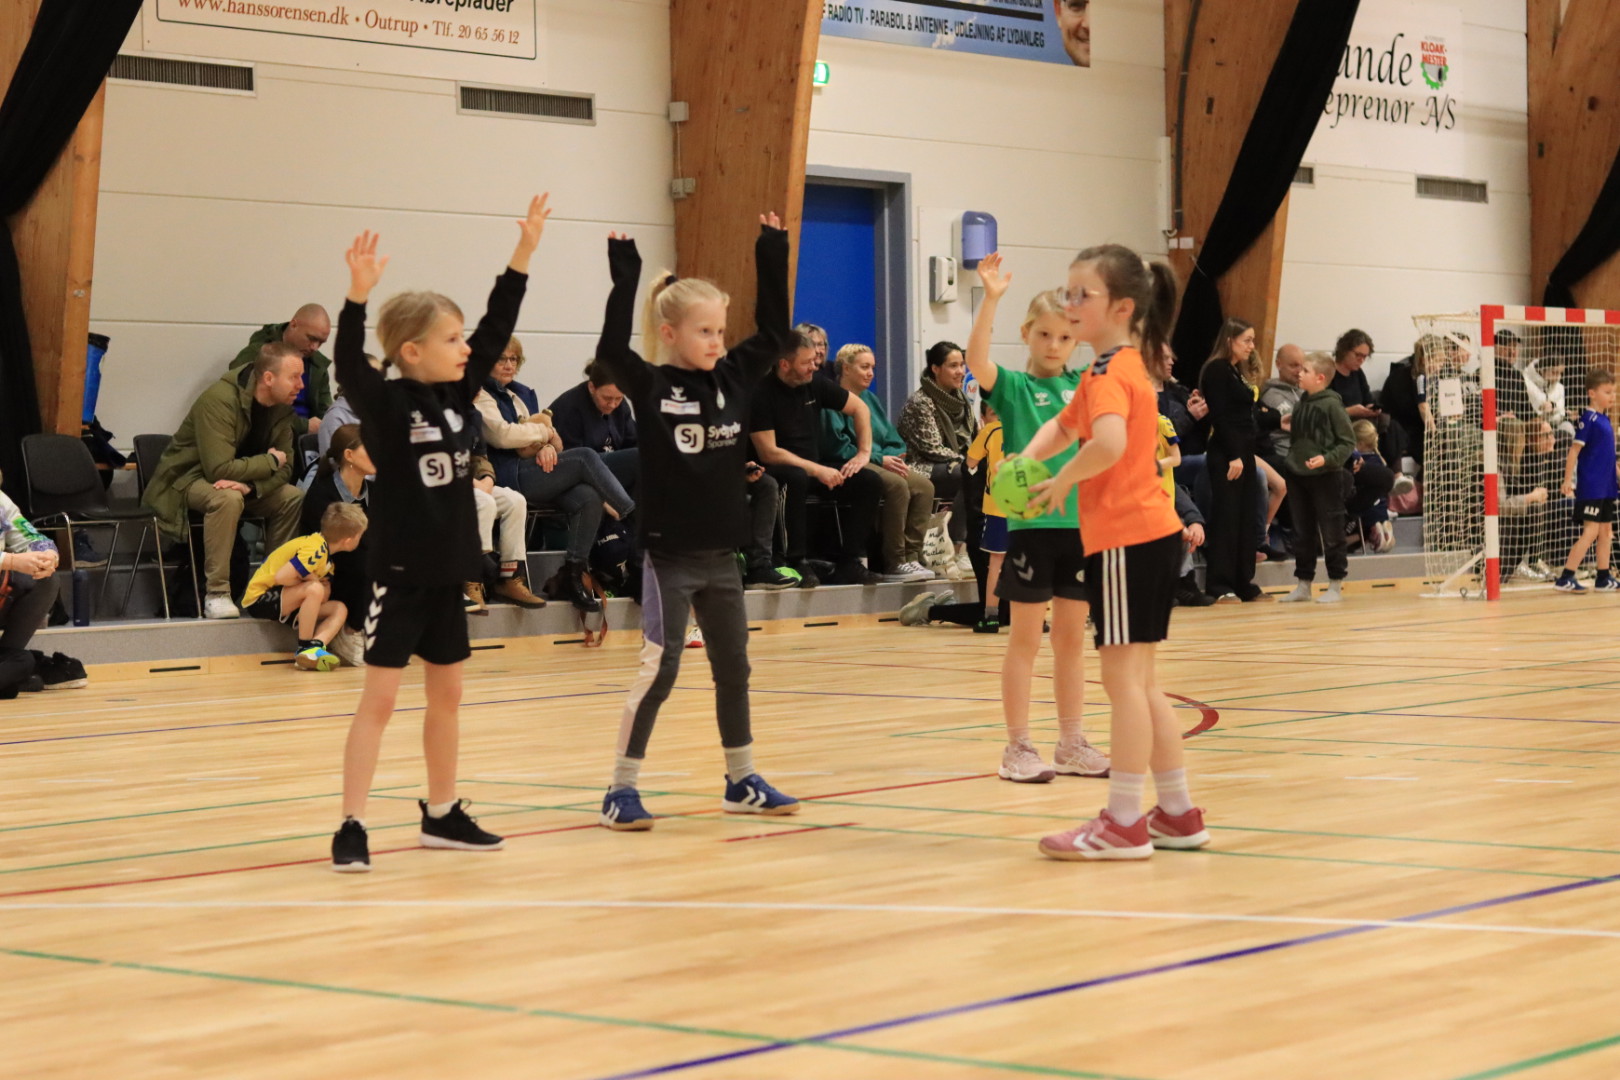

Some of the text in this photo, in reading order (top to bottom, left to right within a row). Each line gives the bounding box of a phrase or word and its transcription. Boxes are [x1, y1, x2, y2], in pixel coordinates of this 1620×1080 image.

[178, 0, 349, 25] www.hanssorensen.dk
[365, 9, 419, 37] Outrup
[433, 20, 454, 37] Tlf.
[458, 24, 472, 39] 20
[475, 27, 488, 40] 65
[492, 29, 505, 43] 56
[508, 30, 520, 44] 12
[828, 3, 853, 23] RADIO
[854, 7, 864, 24] TV
[870, 9, 905, 30] PARABOL
[907, 14, 912, 30] &
[914, 16, 949, 35] ANTENNE
[954, 20, 995, 41] UDLEJNING
[996, 26, 1006, 42] AF
